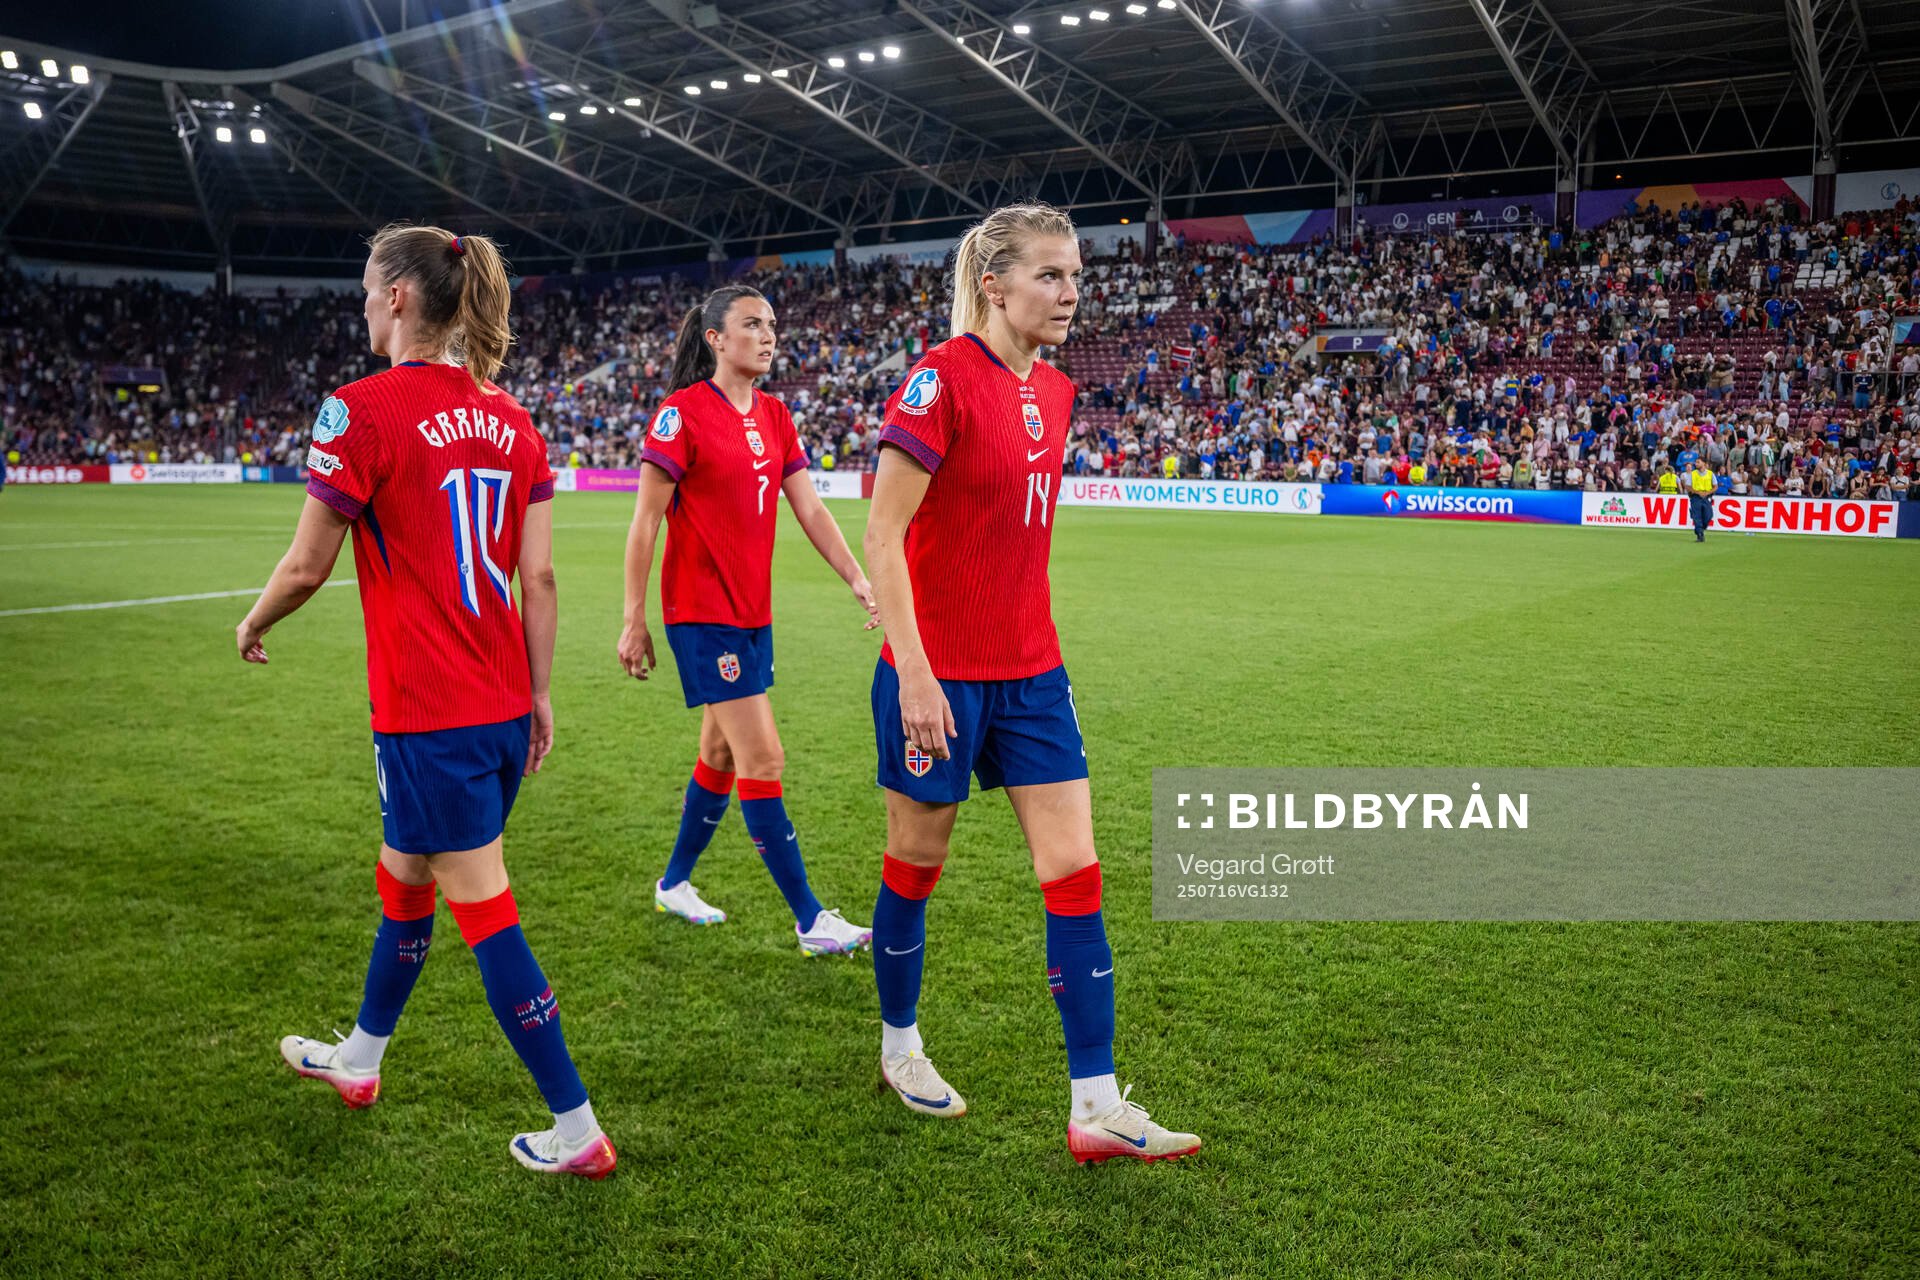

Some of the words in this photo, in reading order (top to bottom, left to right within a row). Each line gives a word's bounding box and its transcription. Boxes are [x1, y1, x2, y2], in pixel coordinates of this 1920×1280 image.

[1427, 210, 1484, 225] GENA
[417, 408, 516, 455] GRAHAM
[758, 475, 770, 515] 7
[1023, 472, 1051, 527] 14
[1074, 483, 1121, 500] UEFA
[1125, 485, 1217, 504] WOMEN'S
[1223, 488, 1279, 506] EURO
[1406, 490, 1513, 514] swisscom
[1586, 515, 1642, 524] WIESENHOF
[1643, 497, 1893, 533] WISENHOF
[439, 468, 513, 618] 10
